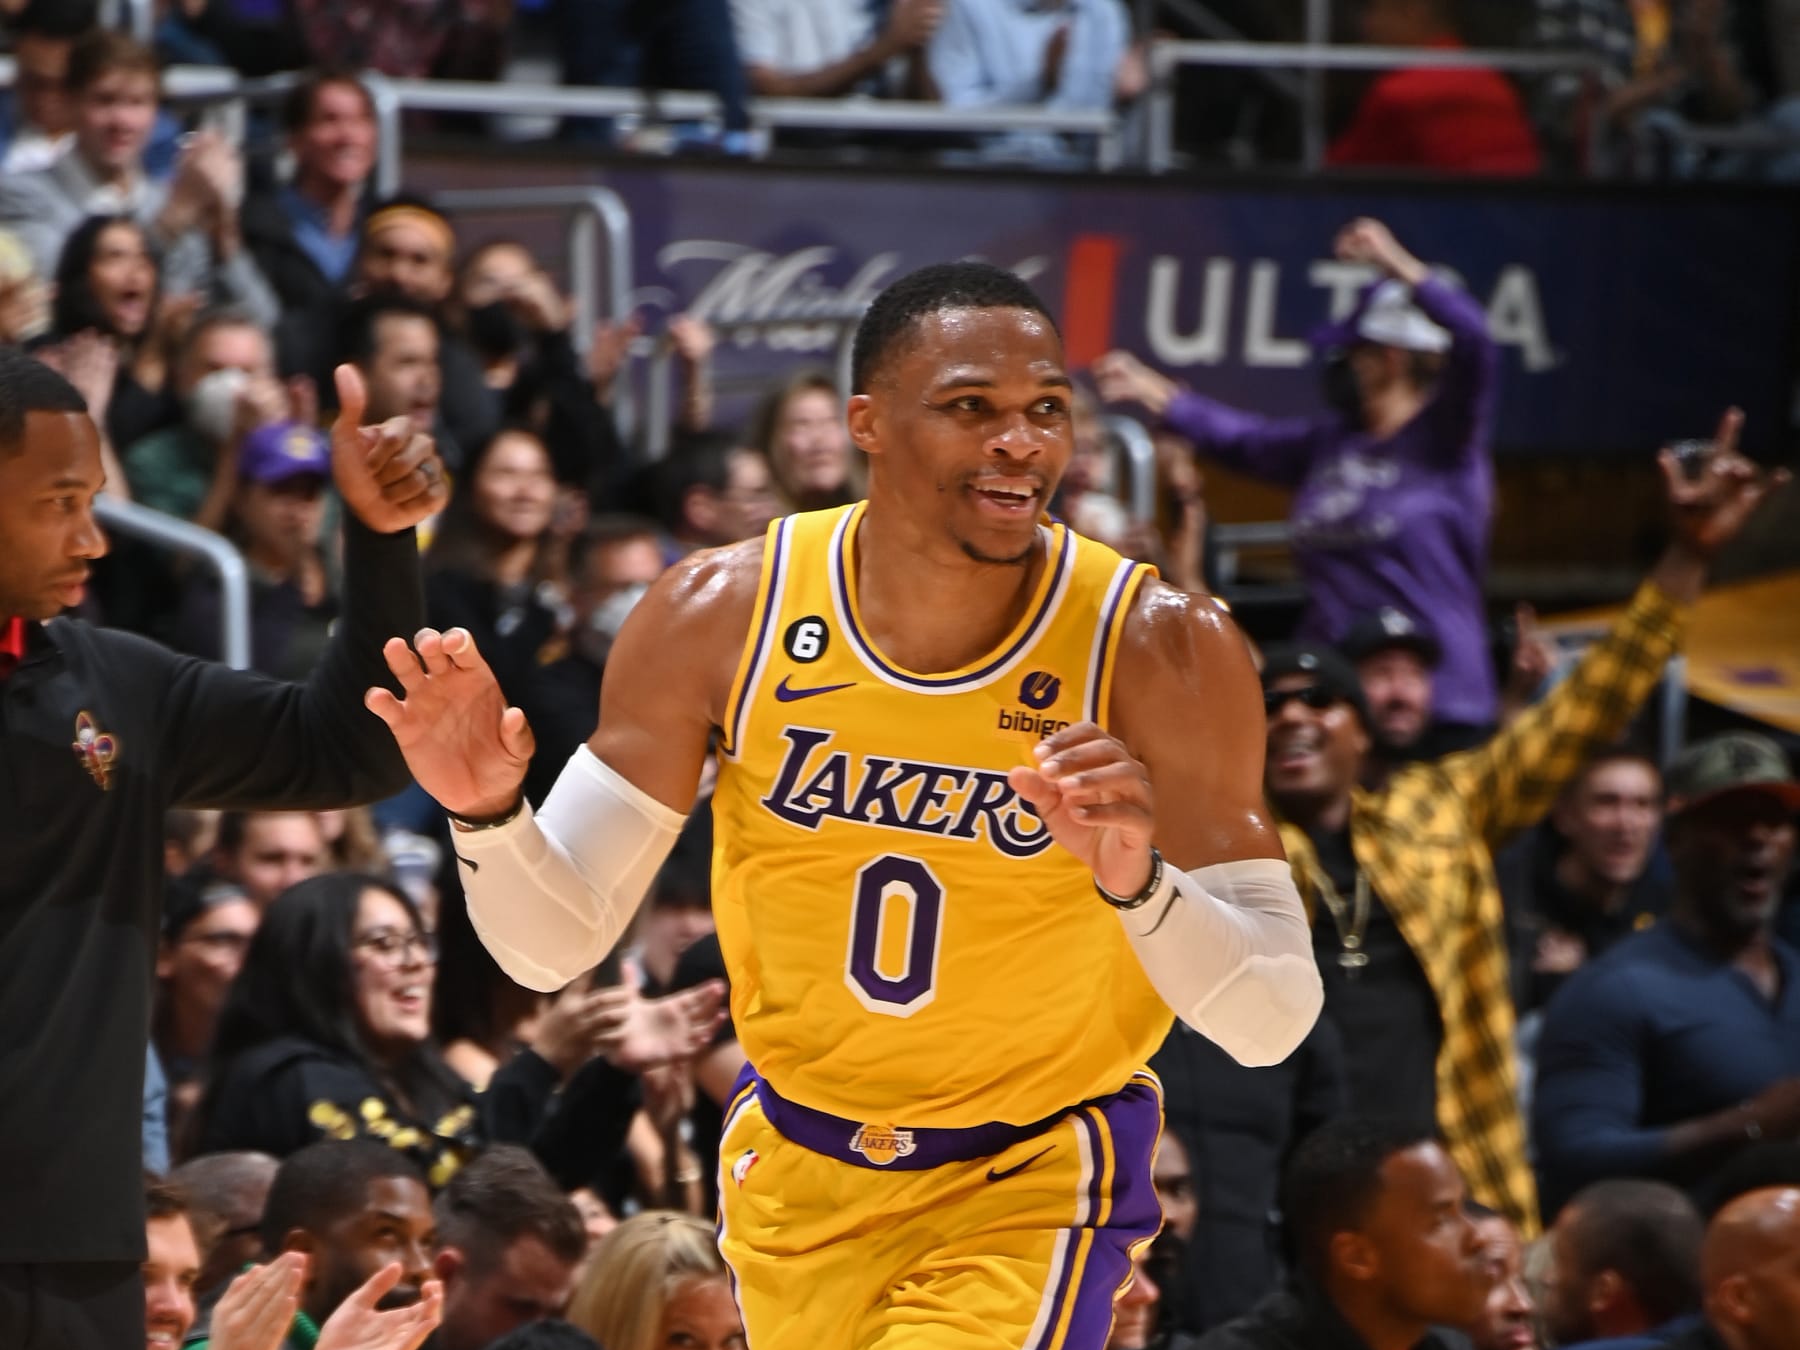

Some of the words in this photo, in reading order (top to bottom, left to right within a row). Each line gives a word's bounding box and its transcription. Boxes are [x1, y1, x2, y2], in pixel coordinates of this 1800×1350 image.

[1146, 256, 1556, 372] ULTA
[791, 622, 823, 658] 6
[843, 852, 948, 1019] 0
[855, 1131, 912, 1155] LAKERS
